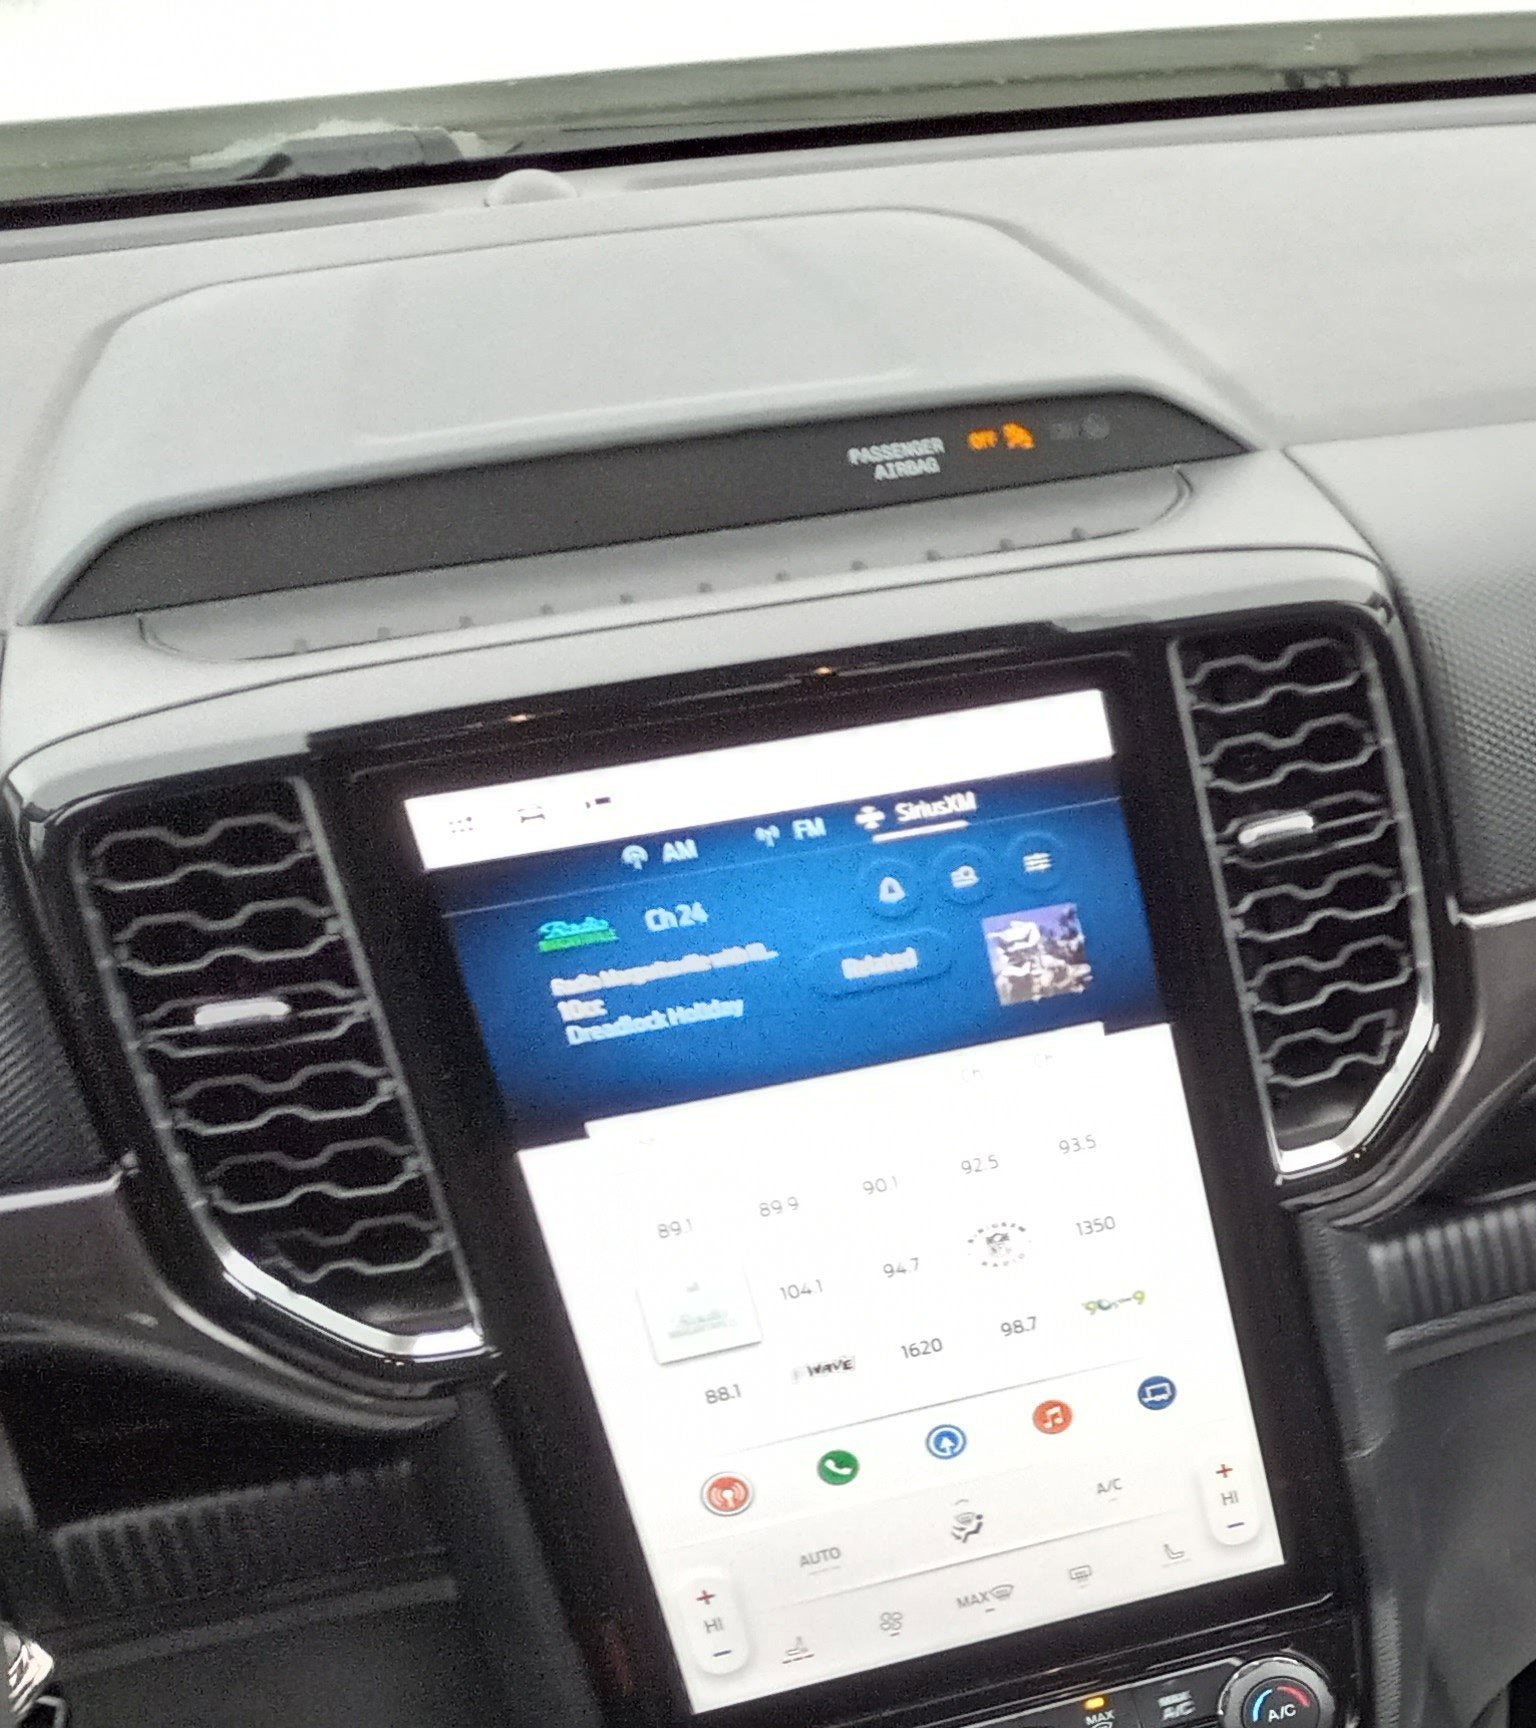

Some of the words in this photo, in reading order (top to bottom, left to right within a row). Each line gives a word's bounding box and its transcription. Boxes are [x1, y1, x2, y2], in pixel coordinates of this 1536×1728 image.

[847, 436, 945, 465] PASSENGER
[874, 457, 941, 482] AIRBAG
[894, 791, 978, 822] SiriusXM
[792, 817, 827, 840] FM
[662, 839, 699, 864] AM
[666, 998, 744, 1027] Holiday
[1058, 1134, 1097, 1154] 93.5
[960, 1154, 999, 1175] 92.5
[862, 1175, 899, 1195] 90.1
[759, 1196, 800, 1218] 89.9
[657, 1218, 694, 1239] 89.1
[1075, 1215, 1117, 1237] 1350
[883, 1257, 920, 1278] 94.7
[779, 1278, 824, 1301] 104.1
[1000, 1316, 1038, 1337] 98.7
[900, 1338, 943, 1359] 1620
[704, 1383, 743, 1405] 88.1
[1096, 1477, 1123, 1495] A/C
[1220, 1489, 1240, 1506] HI
[798, 1547, 842, 1568] AUTO
[956, 1590, 989, 1610] MAX
[704, 1617, 724, 1634] HI
[1085, 1709, 1116, 1726] MAX
[1161, 1700, 1197, 1721] A/C
[1267, 1703, 1297, 1723] A/C
